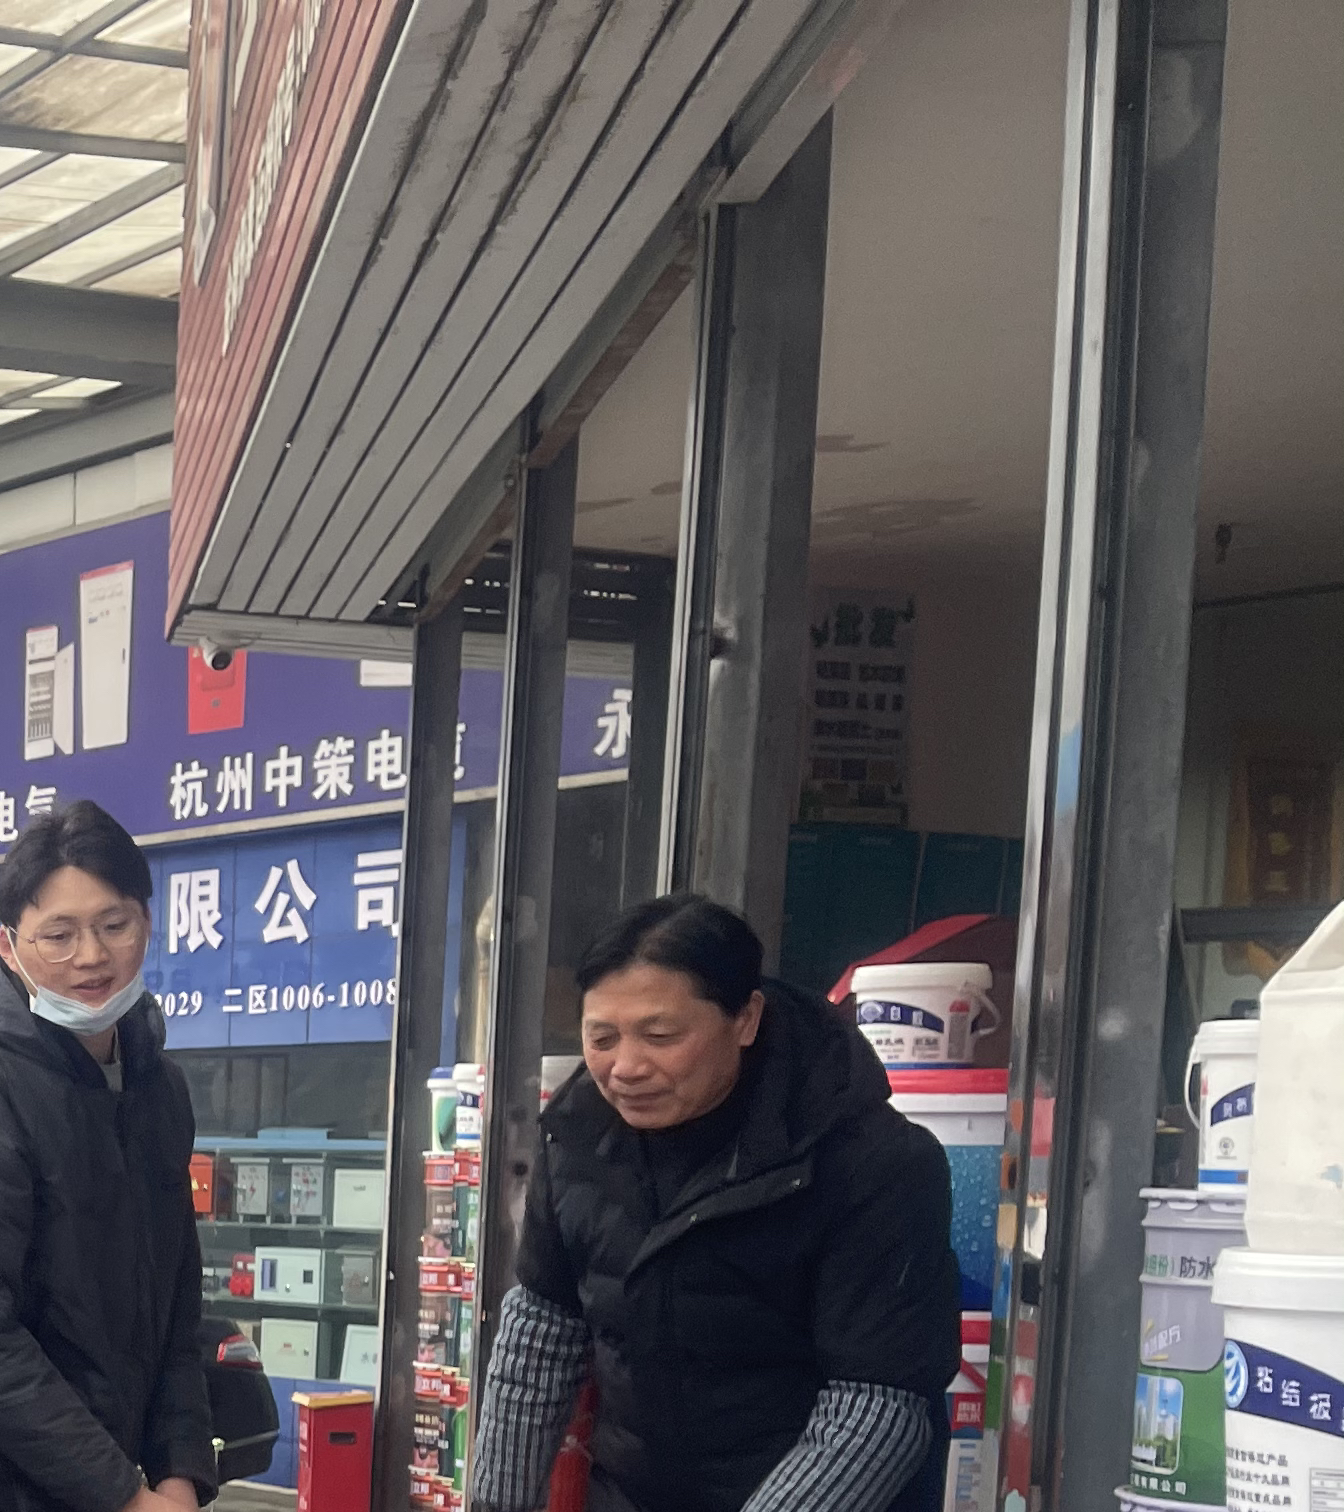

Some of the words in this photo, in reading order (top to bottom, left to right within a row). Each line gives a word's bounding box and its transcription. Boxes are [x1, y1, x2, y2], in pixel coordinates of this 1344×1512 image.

[170, 722, 466, 819] 杭州中策电
[222, 978, 397, 1015] 二区1006-1008
